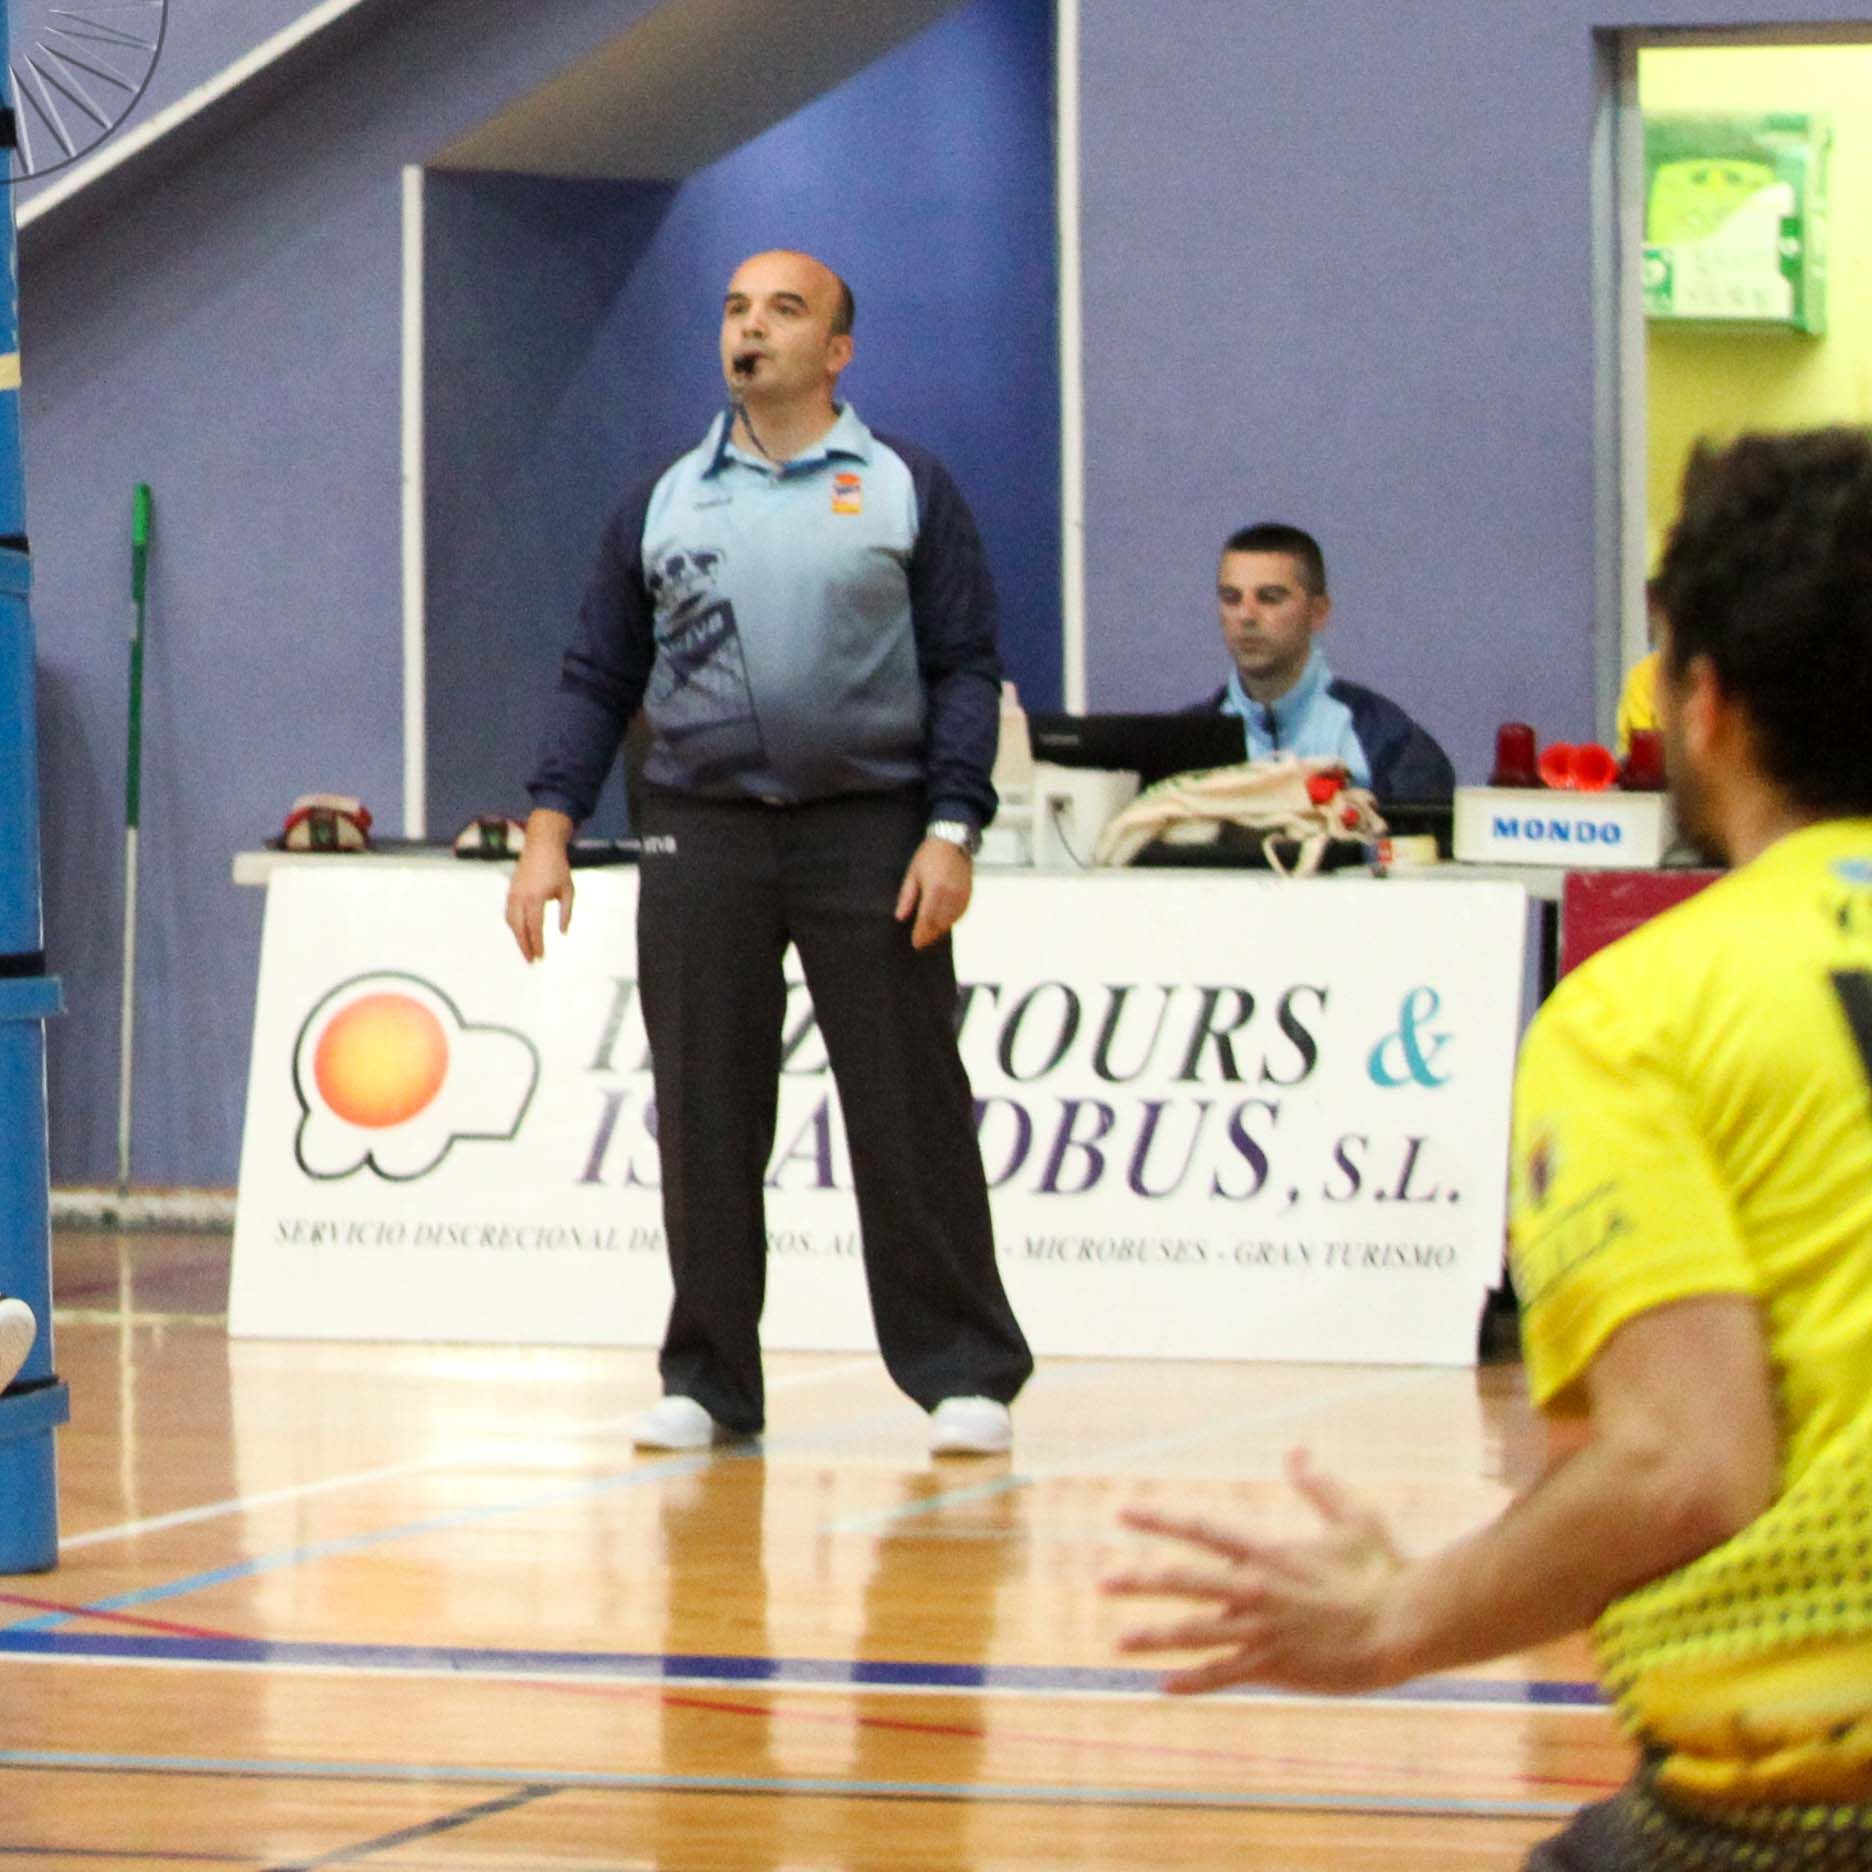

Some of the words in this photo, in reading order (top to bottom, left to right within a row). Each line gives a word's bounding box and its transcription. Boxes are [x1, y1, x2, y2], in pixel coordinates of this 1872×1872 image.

[1492, 815, 1623, 845] MONDO
[1367, 985, 1455, 1089] &
[1321, 1132, 1463, 1205] S.L.
[273, 1217, 409, 1248] SERVICIO
[413, 1220, 622, 1253] DISCRECIONAL
[1022, 1232, 1209, 1264] MICROBUSES
[1232, 1235, 1312, 1266] GRAN
[1322, 1237, 1459, 1267] TURISMO
